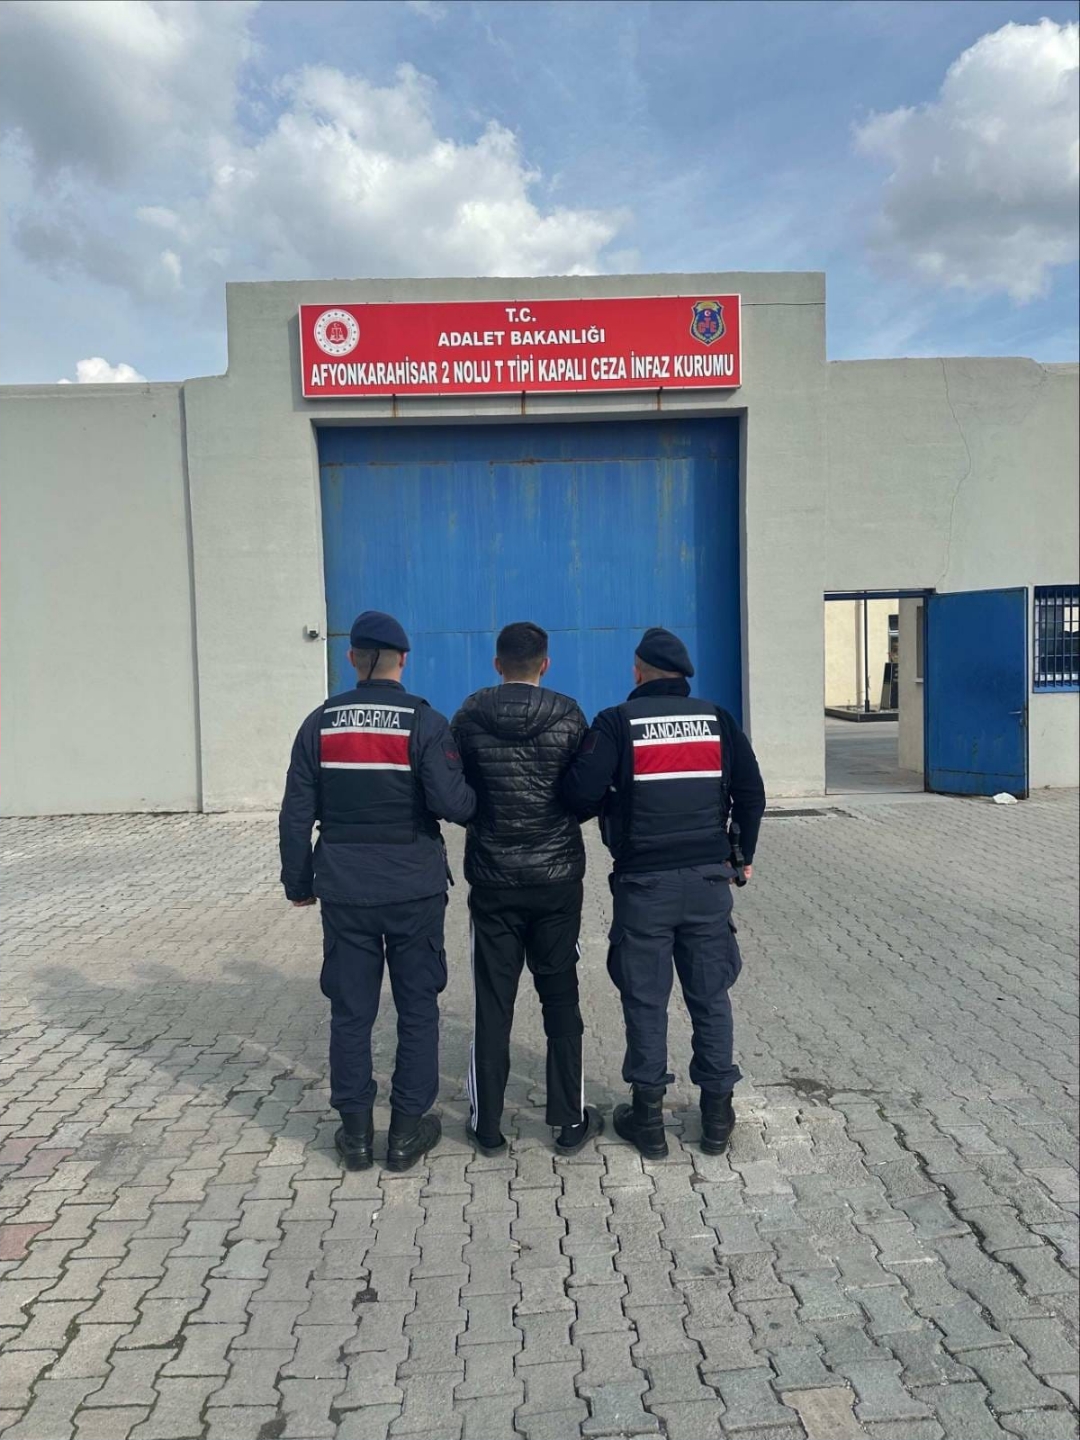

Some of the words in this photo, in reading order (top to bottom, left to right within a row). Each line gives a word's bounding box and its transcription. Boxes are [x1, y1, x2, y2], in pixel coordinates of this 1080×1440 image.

[505, 307, 537, 323] T.C.
[438, 331, 505, 347] ADALET
[510, 325, 606, 346] BAKANLIĞI
[310, 356, 438, 387] AFYONKARAHİSAR
[441, 361, 450, 384] 2
[453, 360, 491, 384] NOLU
[494, 360, 504, 383] T
[507, 354, 534, 383] TİPİ
[538, 357, 587, 383] KAPALI
[590, 356, 628, 380] CEZA
[630, 350, 670, 379] İNFAZ
[673, 353, 735, 378] KURUMU
[331, 709, 401, 729] JANDARMA
[642, 720, 711, 740] JANDARMA
